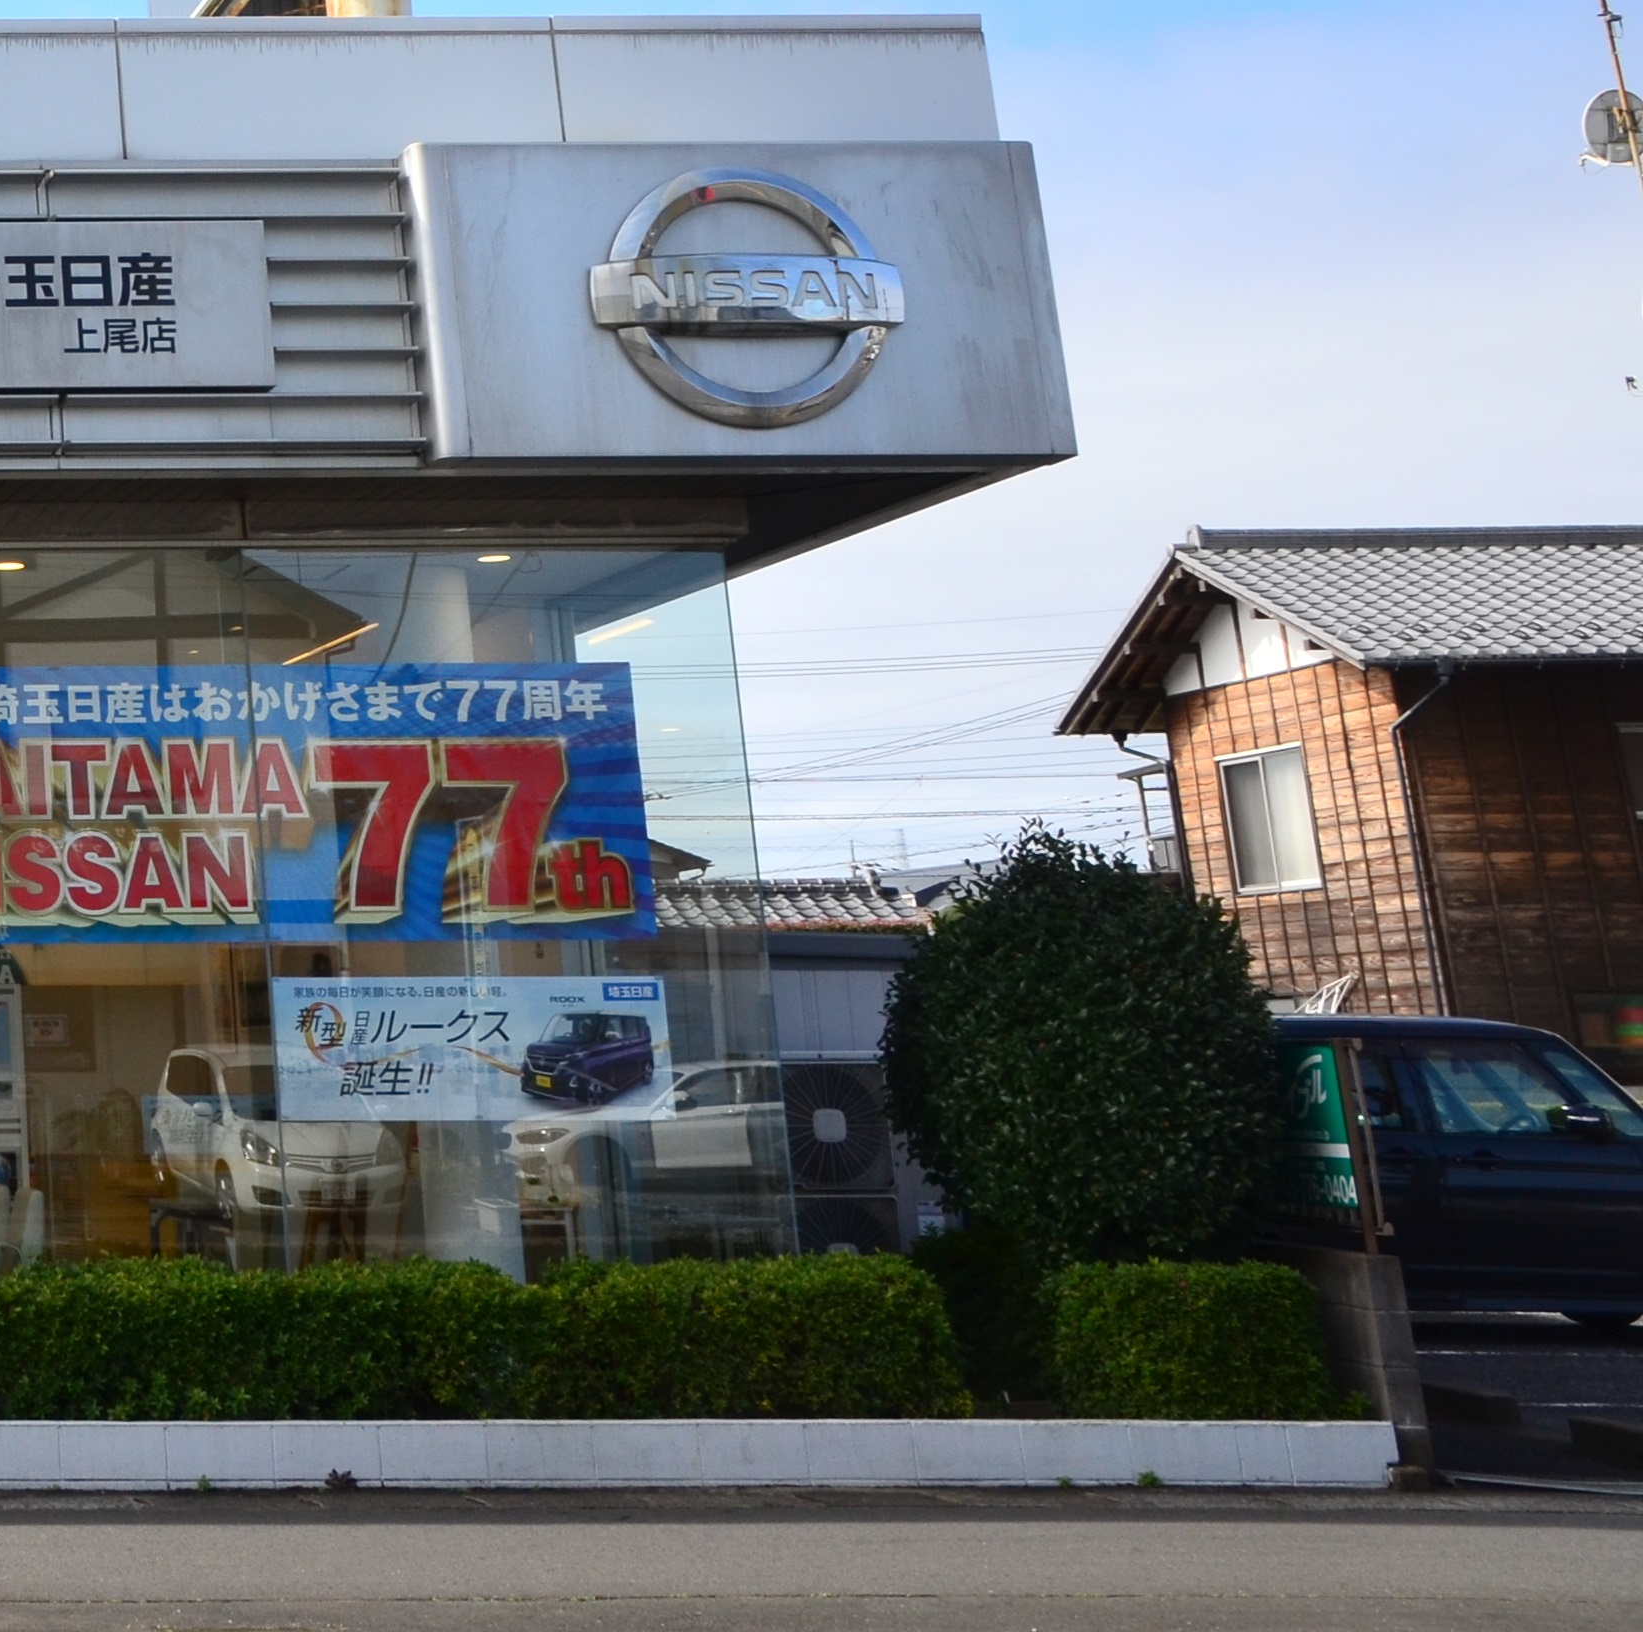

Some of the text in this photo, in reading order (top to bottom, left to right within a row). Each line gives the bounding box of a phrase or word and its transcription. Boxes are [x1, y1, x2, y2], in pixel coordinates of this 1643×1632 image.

[629, 269, 880, 313] NISSAN
[63, 316, 177, 354] 上尾店
